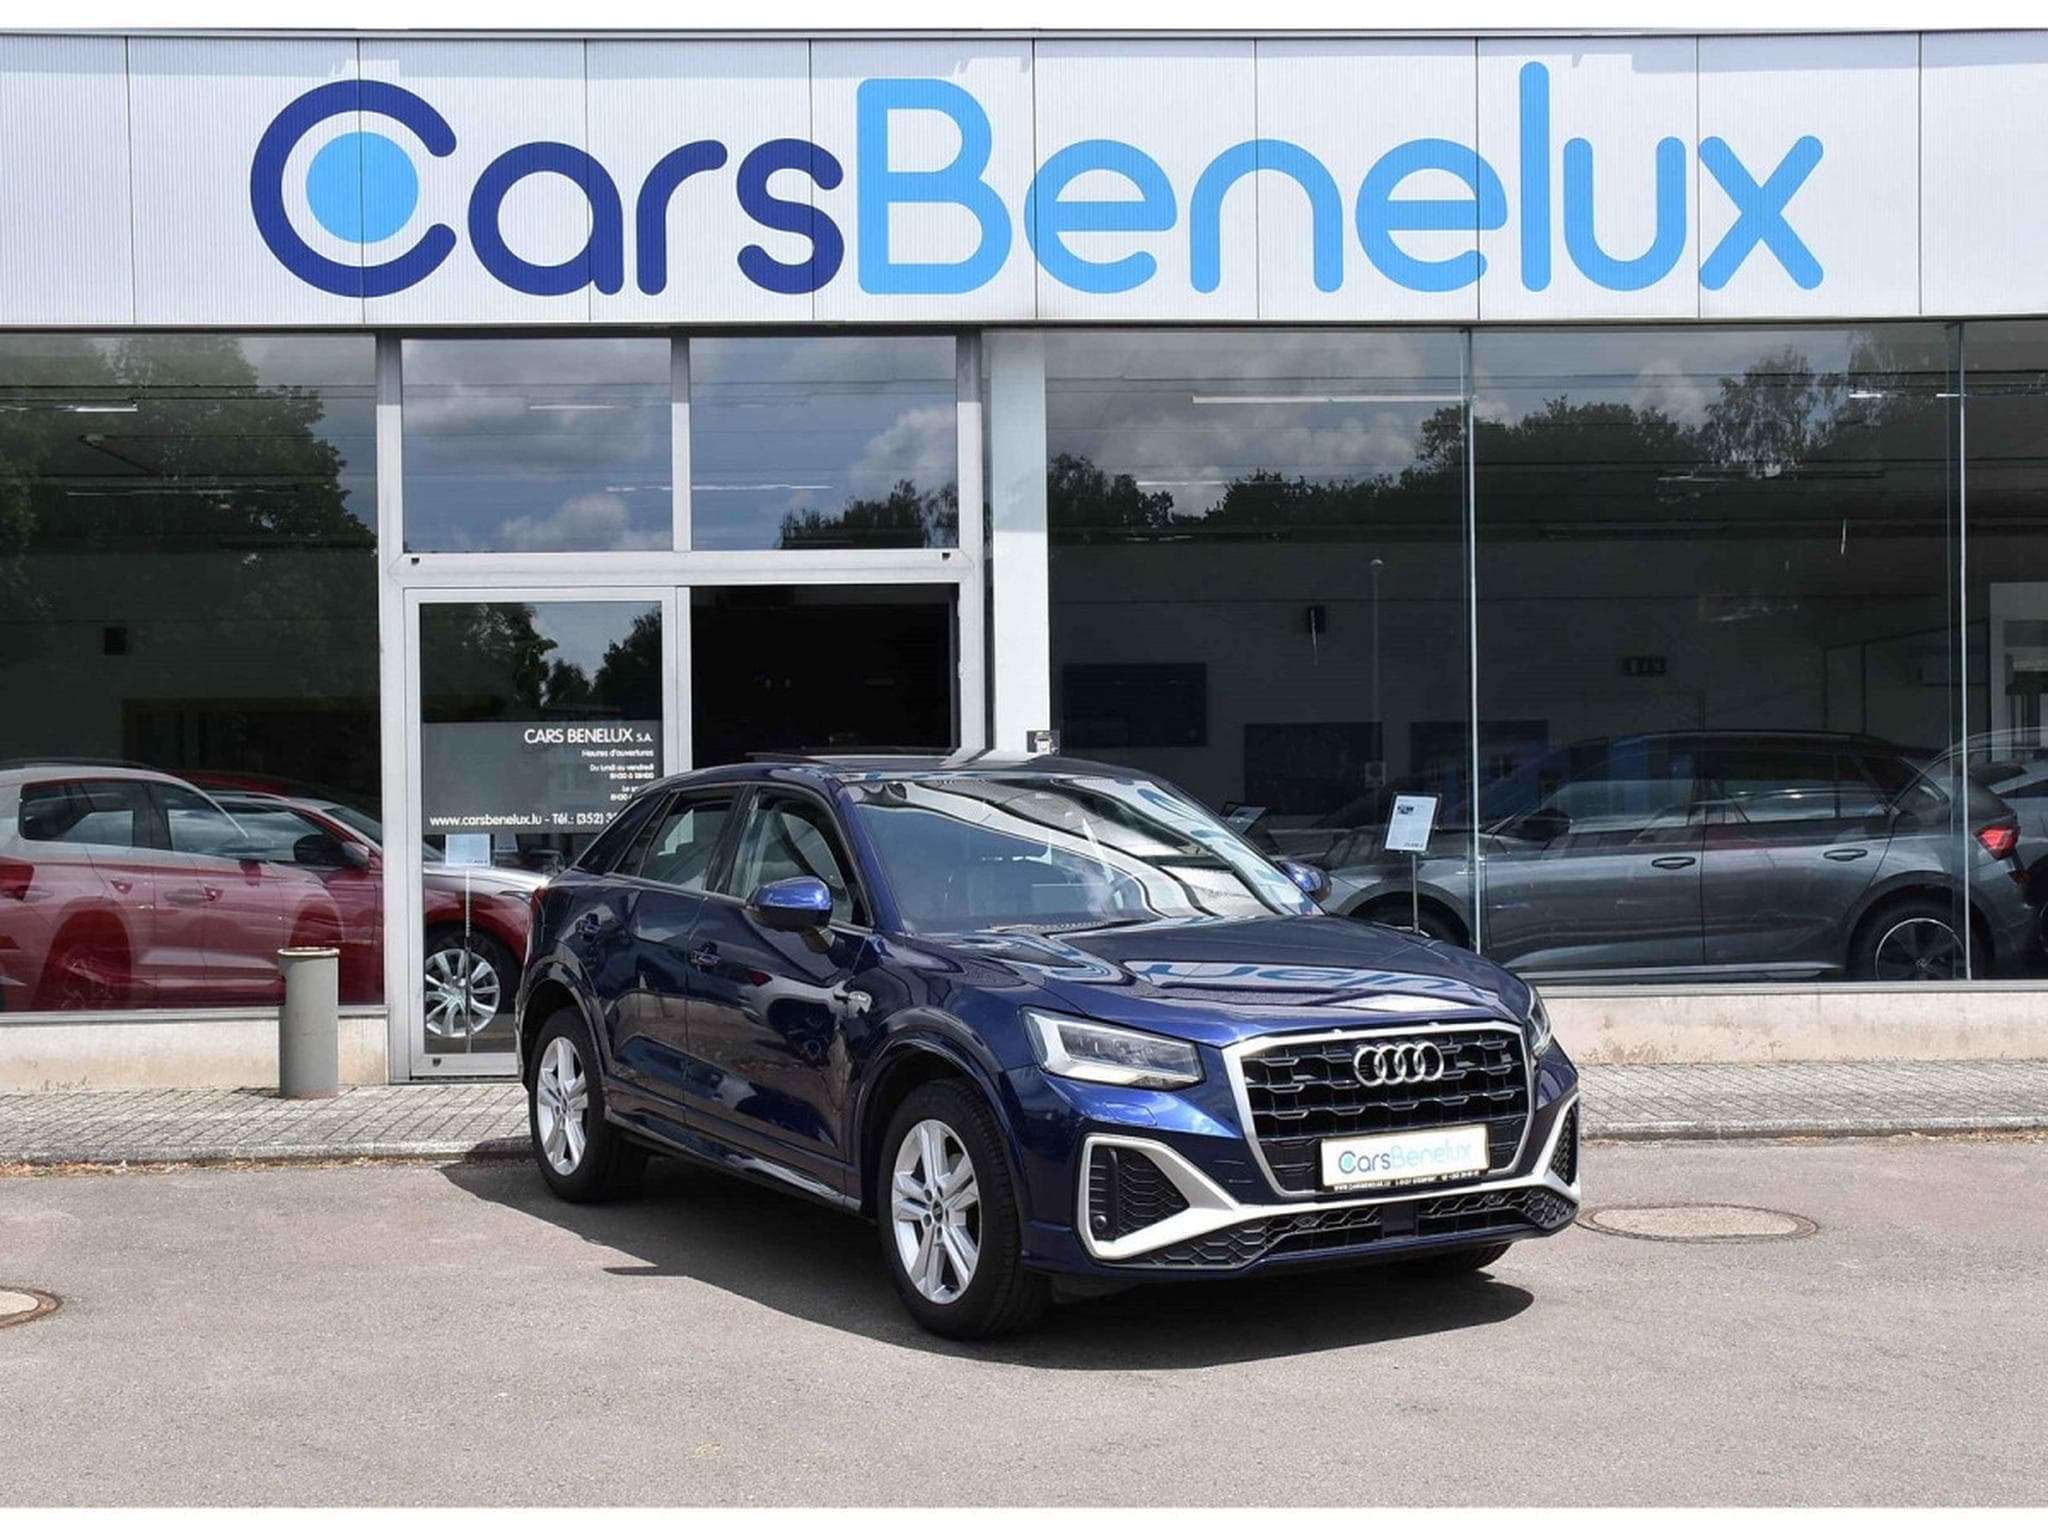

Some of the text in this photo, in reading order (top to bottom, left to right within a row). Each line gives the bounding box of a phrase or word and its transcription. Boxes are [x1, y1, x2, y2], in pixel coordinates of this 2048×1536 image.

[251, 63, 1823, 297] CarsBenelux
[523, 727, 653, 744] CARS BENELUX S.A.
[430, 813, 542, 826] www.carsbenelux.lu
[1337, 1139, 1471, 1175] CarsBenelux
